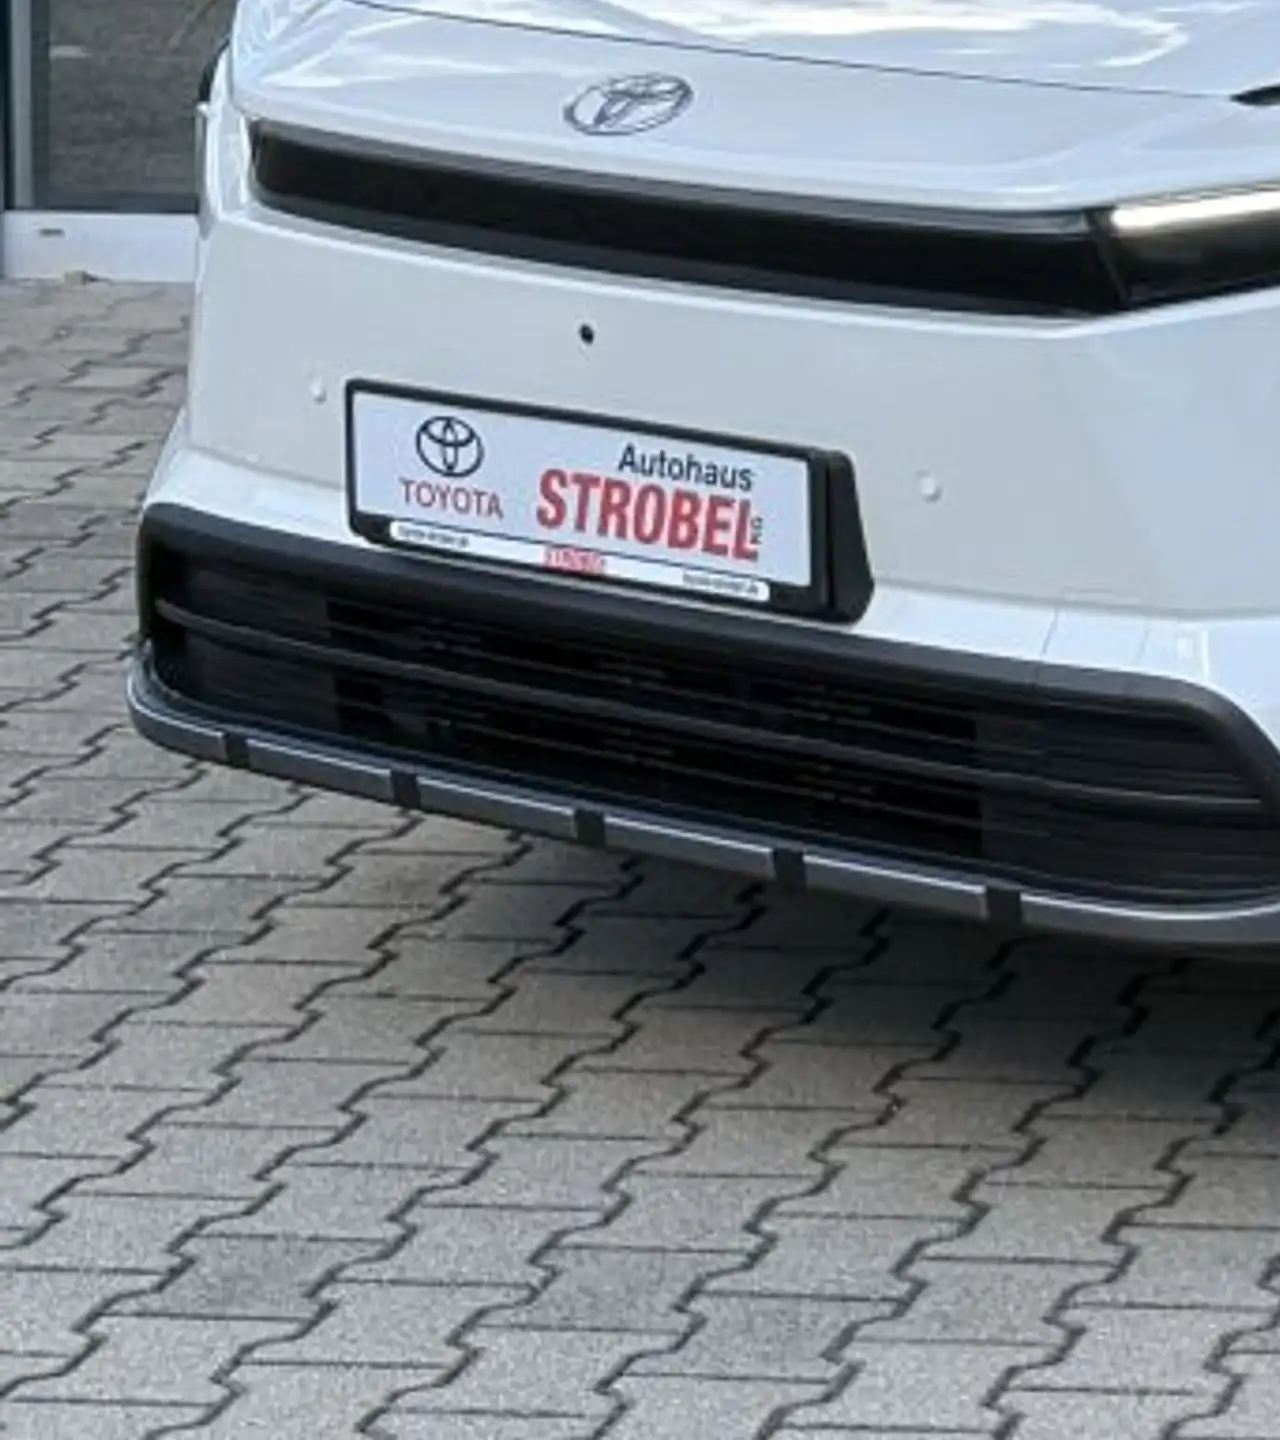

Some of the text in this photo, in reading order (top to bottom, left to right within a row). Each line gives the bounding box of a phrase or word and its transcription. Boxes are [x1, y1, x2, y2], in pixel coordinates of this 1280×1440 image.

[619, 444, 754, 491] Autohaus
[400, 479, 503, 519] TOYOTA
[537, 469, 759, 560] STROBEL
